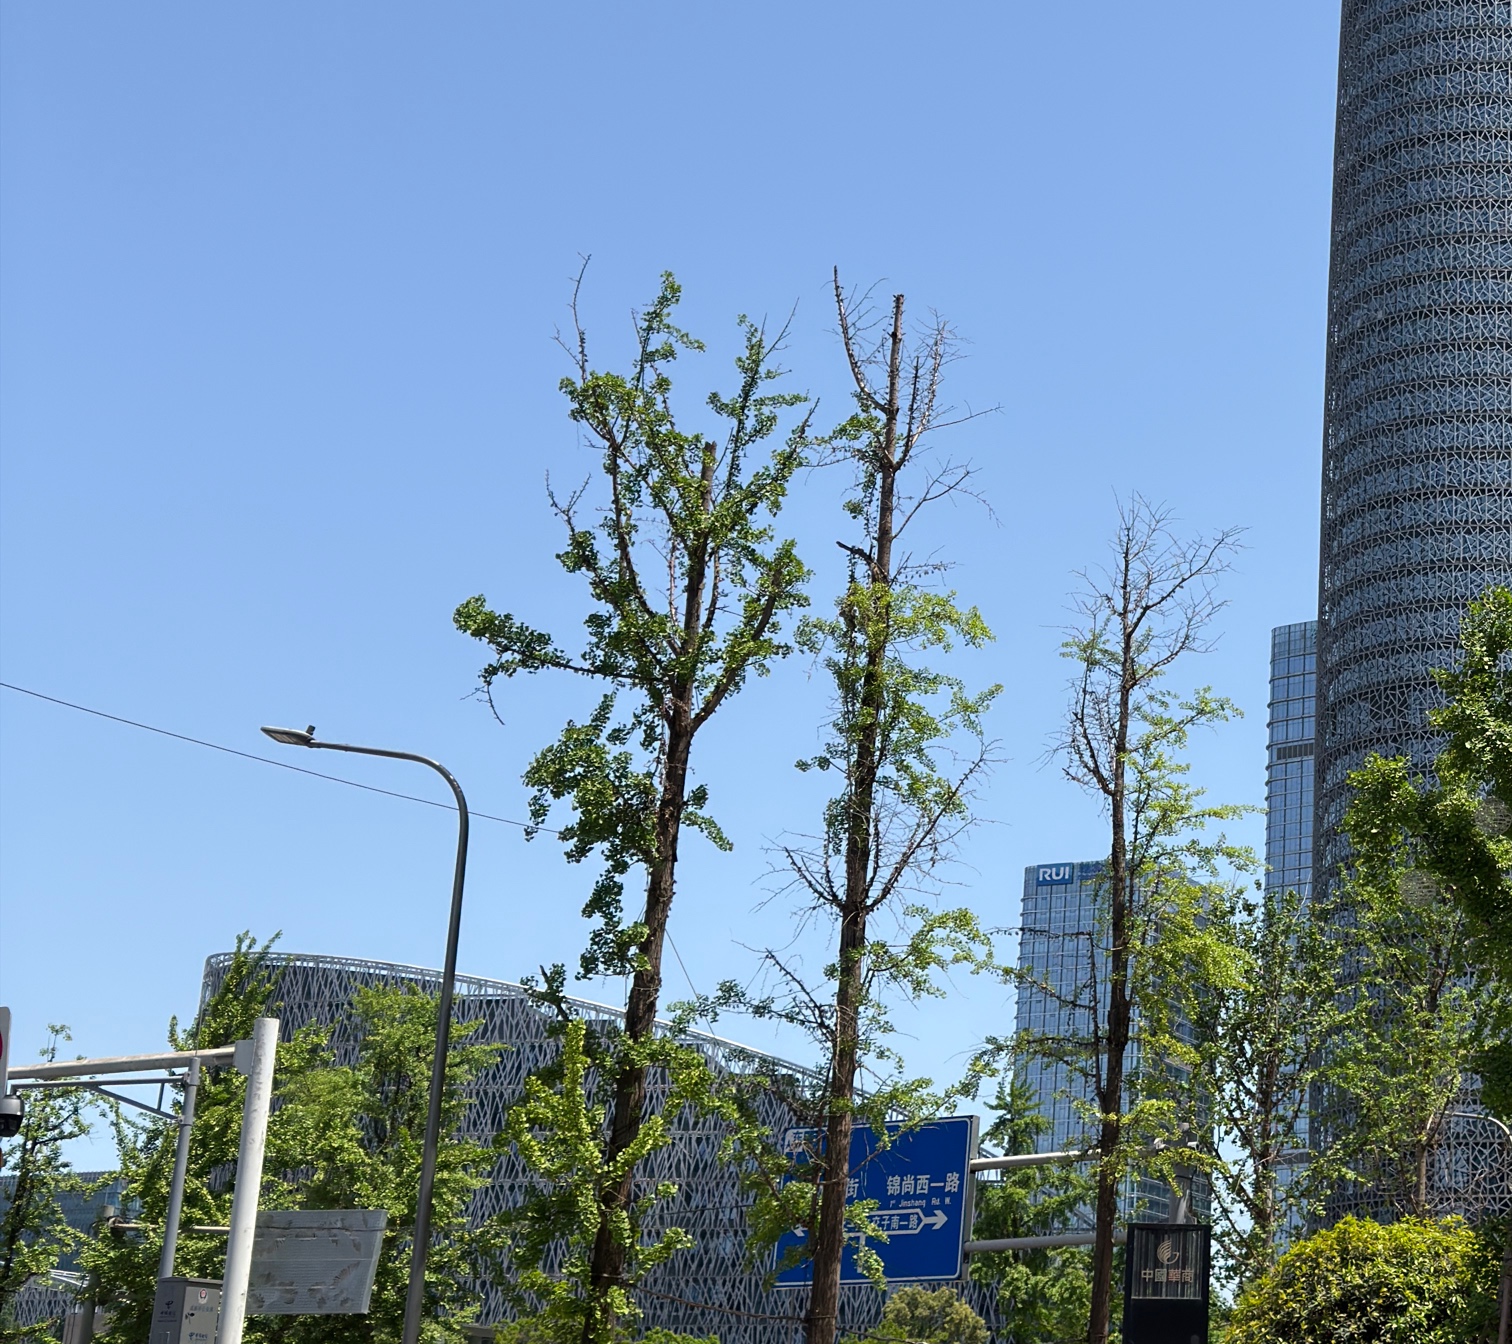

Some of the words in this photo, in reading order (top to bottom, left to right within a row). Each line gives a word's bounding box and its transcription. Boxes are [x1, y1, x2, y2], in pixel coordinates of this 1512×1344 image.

[1039, 866, 1070, 881] RUI
[887, 1172, 960, 1196] 锦尚西一路
[1141, 1268, 1194, 1283] 中國華商
